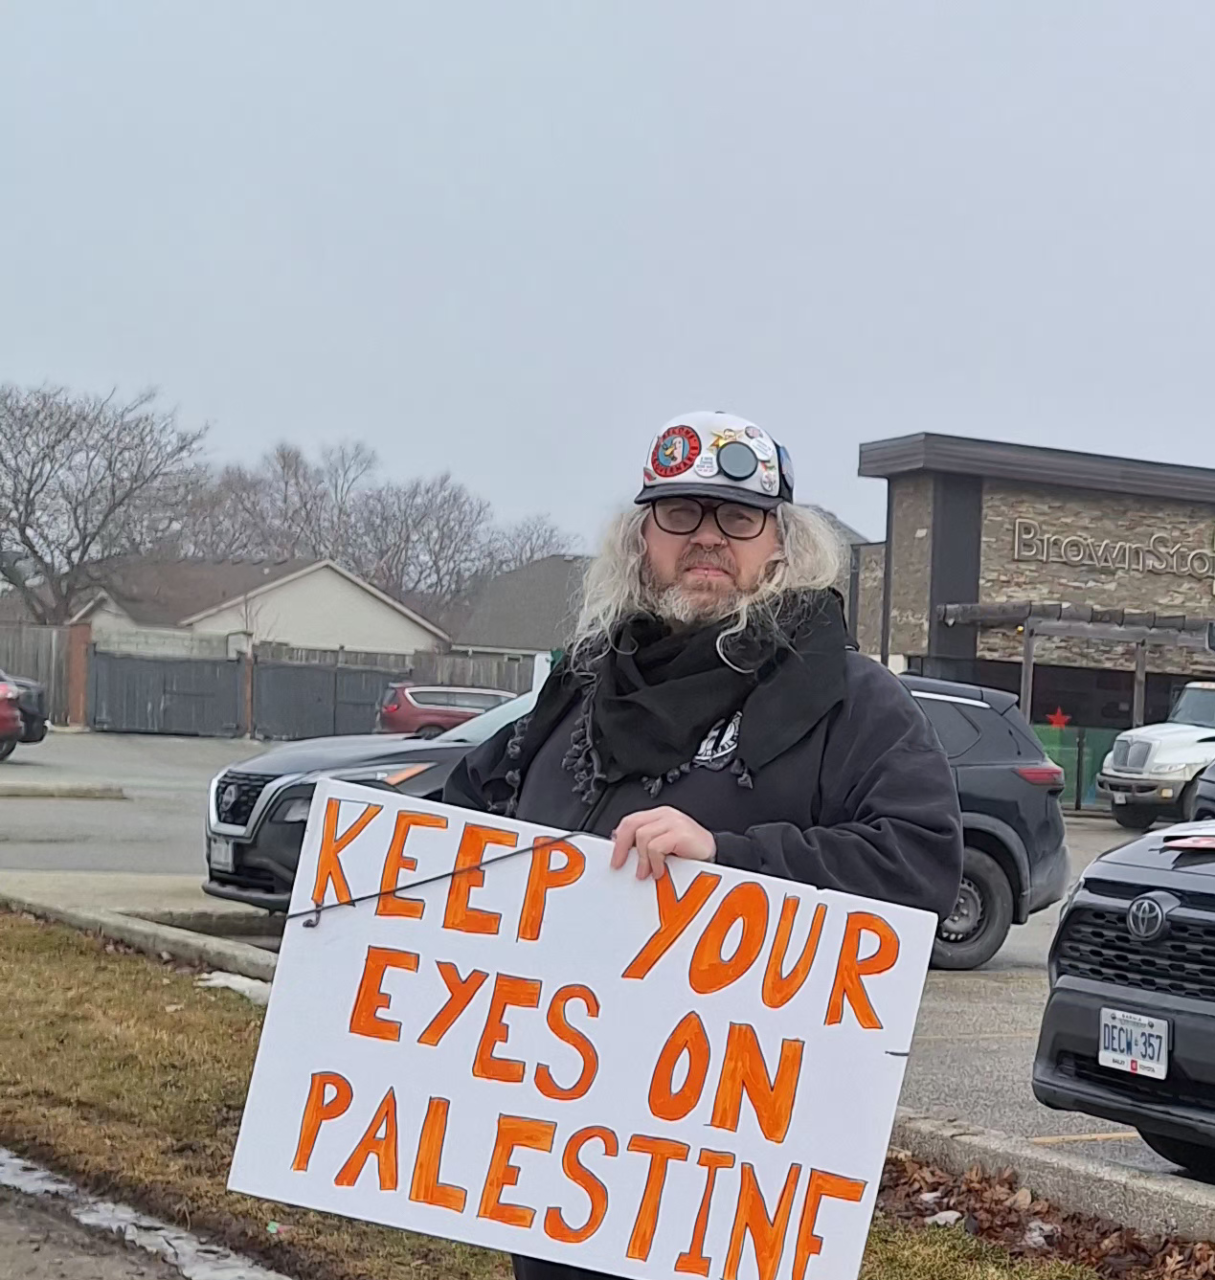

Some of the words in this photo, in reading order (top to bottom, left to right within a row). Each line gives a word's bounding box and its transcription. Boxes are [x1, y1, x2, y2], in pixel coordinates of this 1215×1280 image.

[312, 798, 586, 942] KEEP
[621, 862, 900, 1030] YOUR
[349, 945, 600, 1100] EYES
[647, 1010, 806, 1144] ON
[1140, 1031, 1163, 1062] 357
